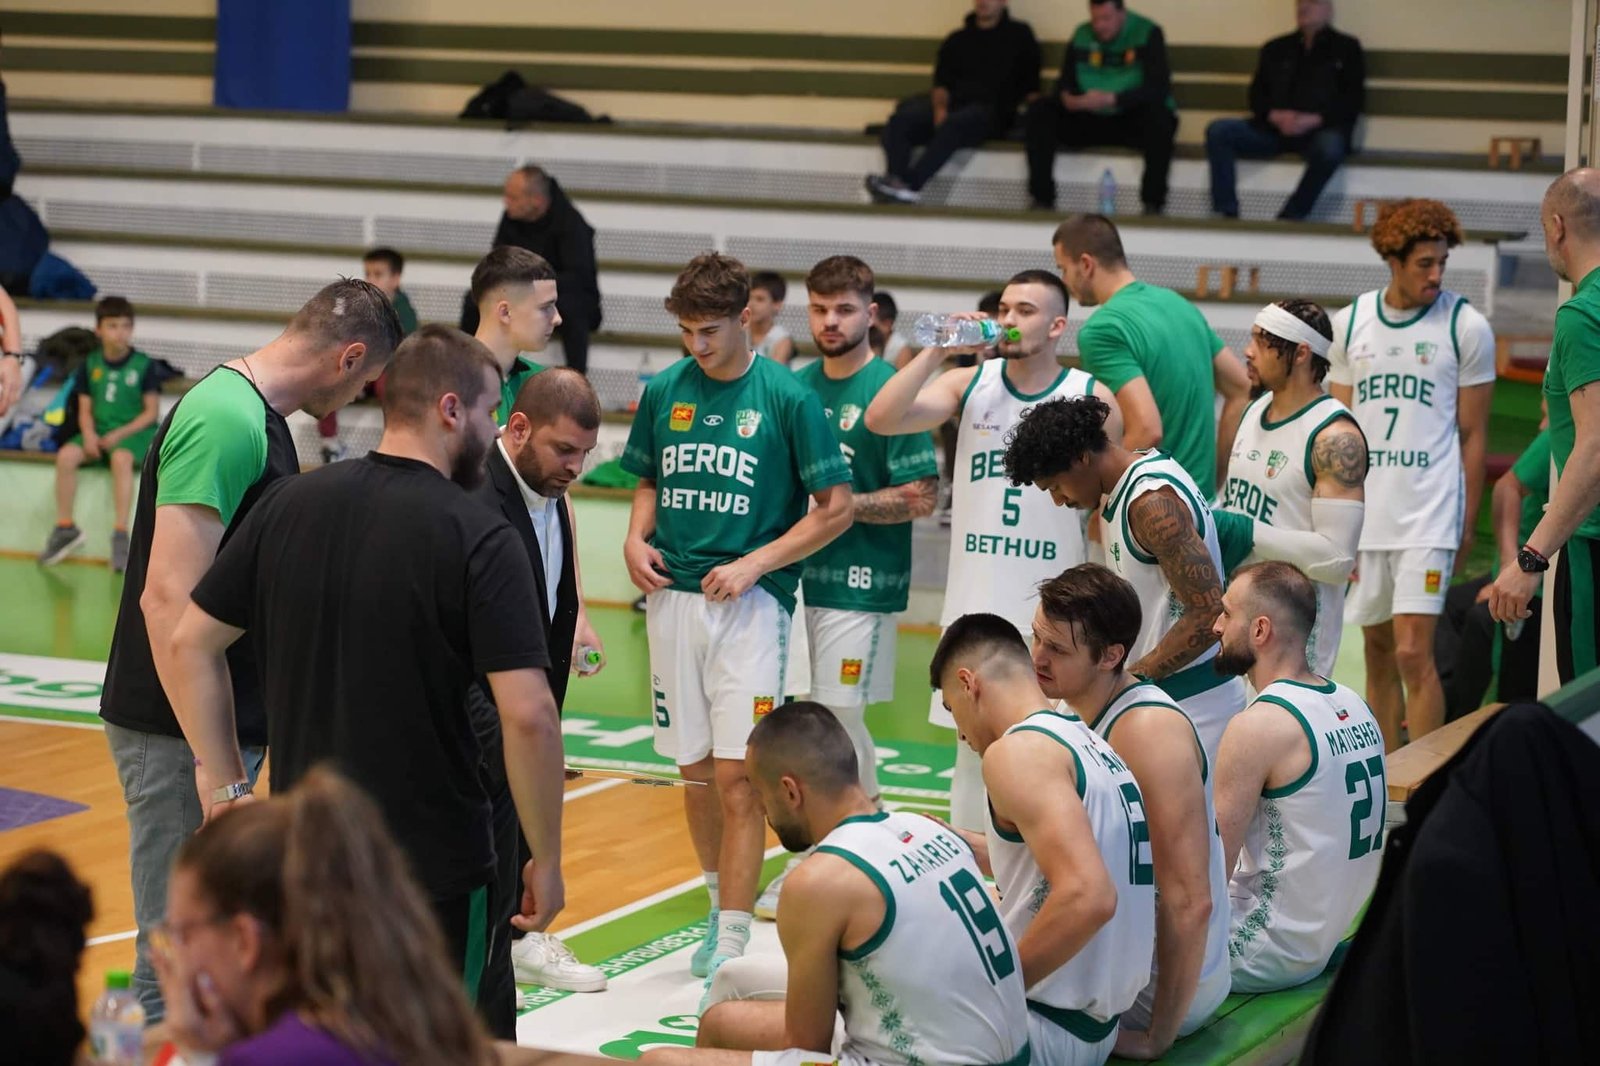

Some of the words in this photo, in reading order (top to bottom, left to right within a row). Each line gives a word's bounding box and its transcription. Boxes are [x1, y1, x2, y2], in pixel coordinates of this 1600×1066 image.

[1383, 407, 1399, 441] 7
[661, 442, 759, 488] BEROE
[1368, 450, 1430, 469] ETHUB
[661, 486, 751, 516] BETHUB
[1001, 487, 1022, 527] 5
[1223, 477, 1279, 527] EROE
[965, 533, 1057, 561] BETHUB
[847, 565, 873, 590] 86
[1344, 754, 1386, 860] 27
[1117, 782, 1154, 886] 12
[889, 834, 963, 884] ZAHARIE
[938, 867, 1016, 986] 19
